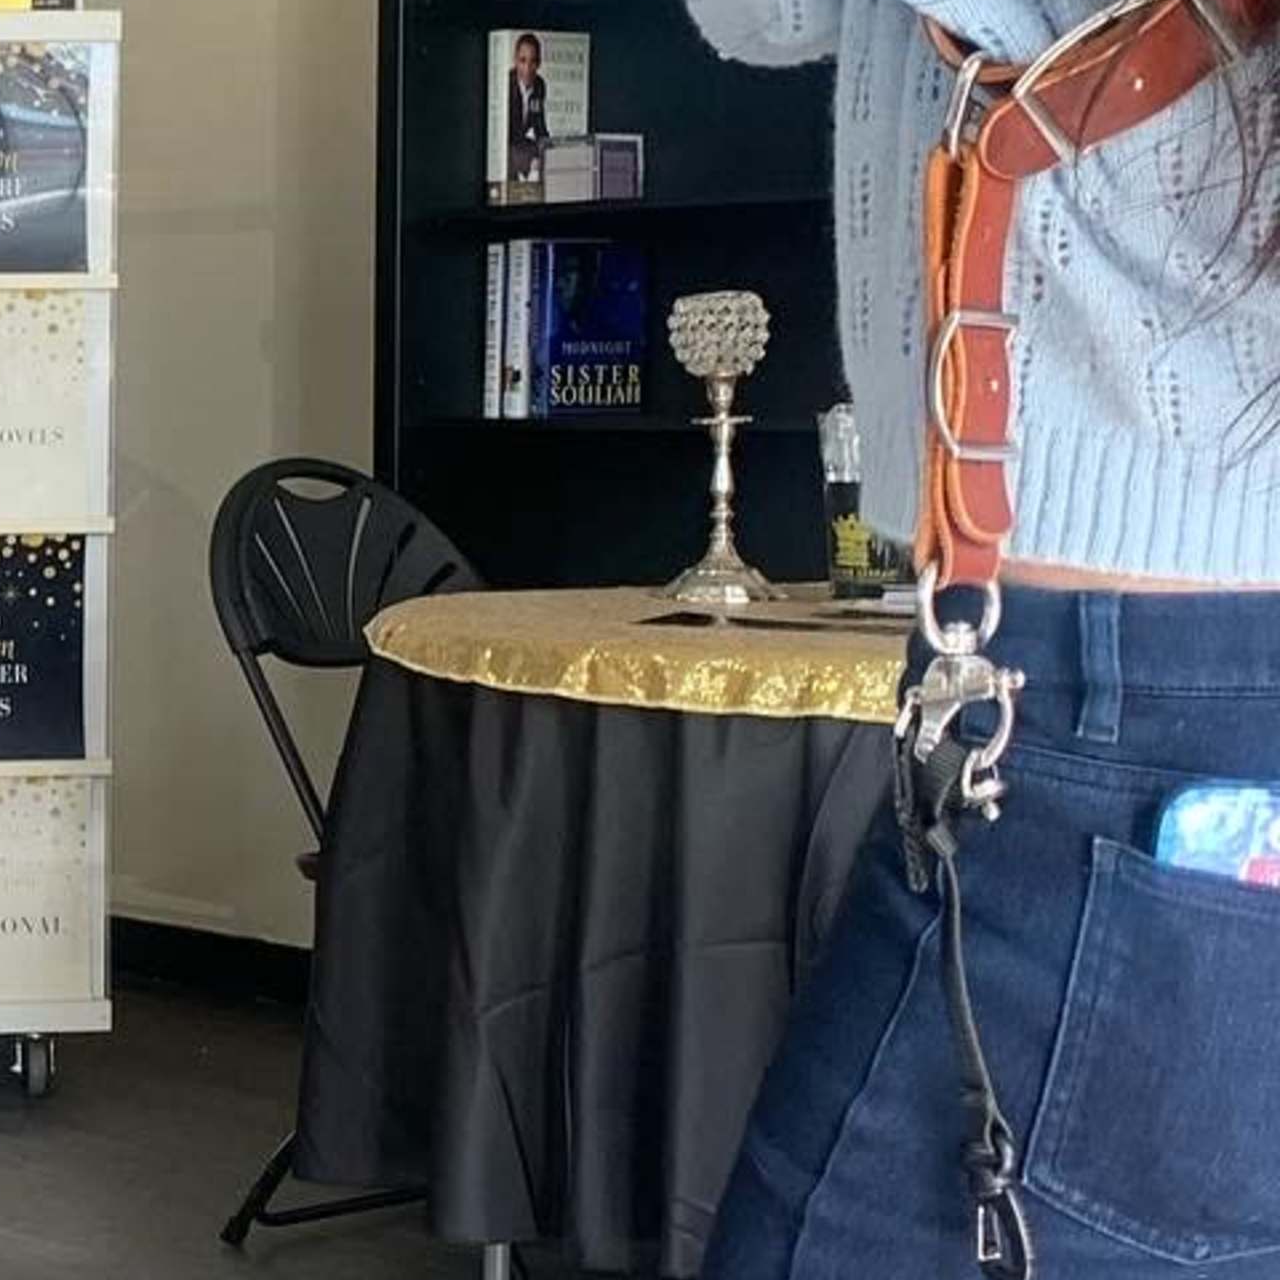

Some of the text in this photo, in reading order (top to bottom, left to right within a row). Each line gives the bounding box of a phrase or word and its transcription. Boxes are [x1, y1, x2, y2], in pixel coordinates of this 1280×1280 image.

[561, 340, 632, 356] MIDNIGHT
[550, 363, 641, 385] SISTER
[550, 384, 641, 407] SOULJAH
